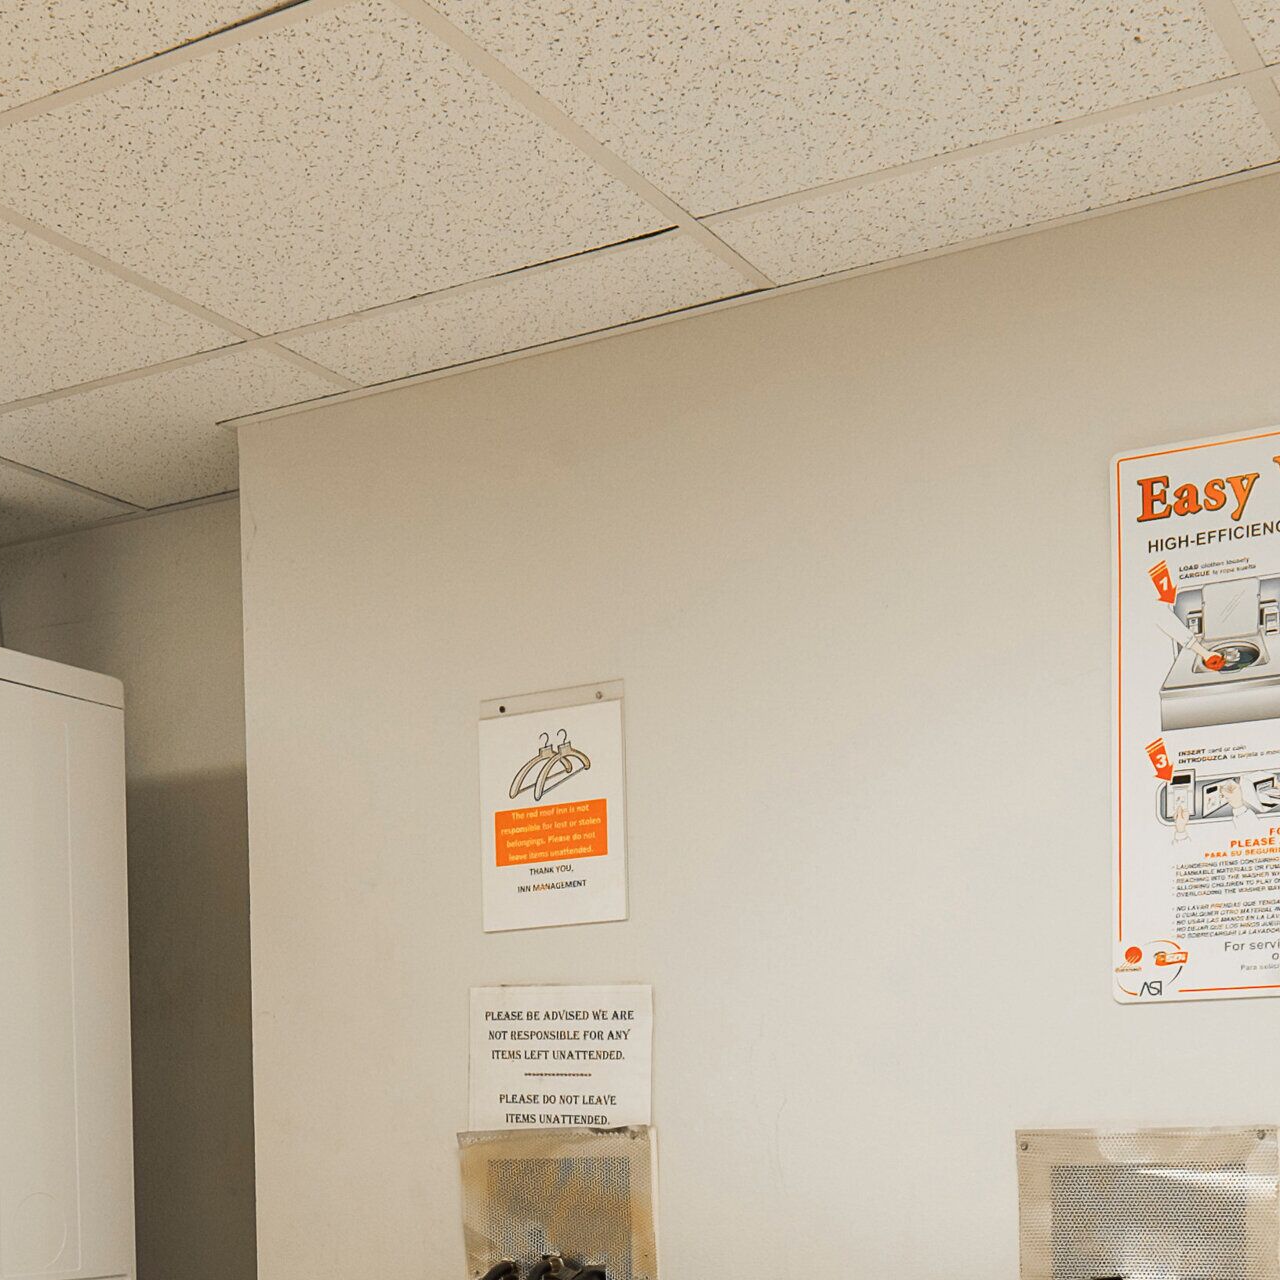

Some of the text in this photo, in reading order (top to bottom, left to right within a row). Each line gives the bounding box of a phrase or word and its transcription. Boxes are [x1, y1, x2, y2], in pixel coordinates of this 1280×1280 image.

[1136, 472, 1260, 522] Easy
[1179, 564, 1198, 572] LOAD
[1160, 577, 1167, 590] 1
[1156, 754, 1167, 768] 3
[512, 811, 524, 820] The
[526, 810, 538, 819] red
[540, 808, 555, 818] roof
[577, 804, 590, 813] not
[501, 822, 540, 836] responsible
[542, 821, 553, 830] for
[554, 819, 568, 829] lost
[579, 816, 601, 827] stolen
[506, 830, 596, 849] belongings. Please do not
[1230, 837, 1275, 848] PLEASE
[508, 846, 594, 862] leave items unattended.
[529, 866, 554, 876] THANK
[518, 879, 586, 893] INN MANAGEMENT
[1224, 941, 1245, 952] For
[485, 1010, 634, 1021] PLEASE BE ADVISED WE ARE
[488, 1029, 630, 1040] NOT RESPONSIBLE FOR ANY
[492, 1050, 625, 1060] ITEMS LEFT UNATTENDED.
[499, 1094, 617, 1105] PLEASE DO NOT LEAVE
[506, 1114, 610, 1125] ITEMS UNATTENDED.
